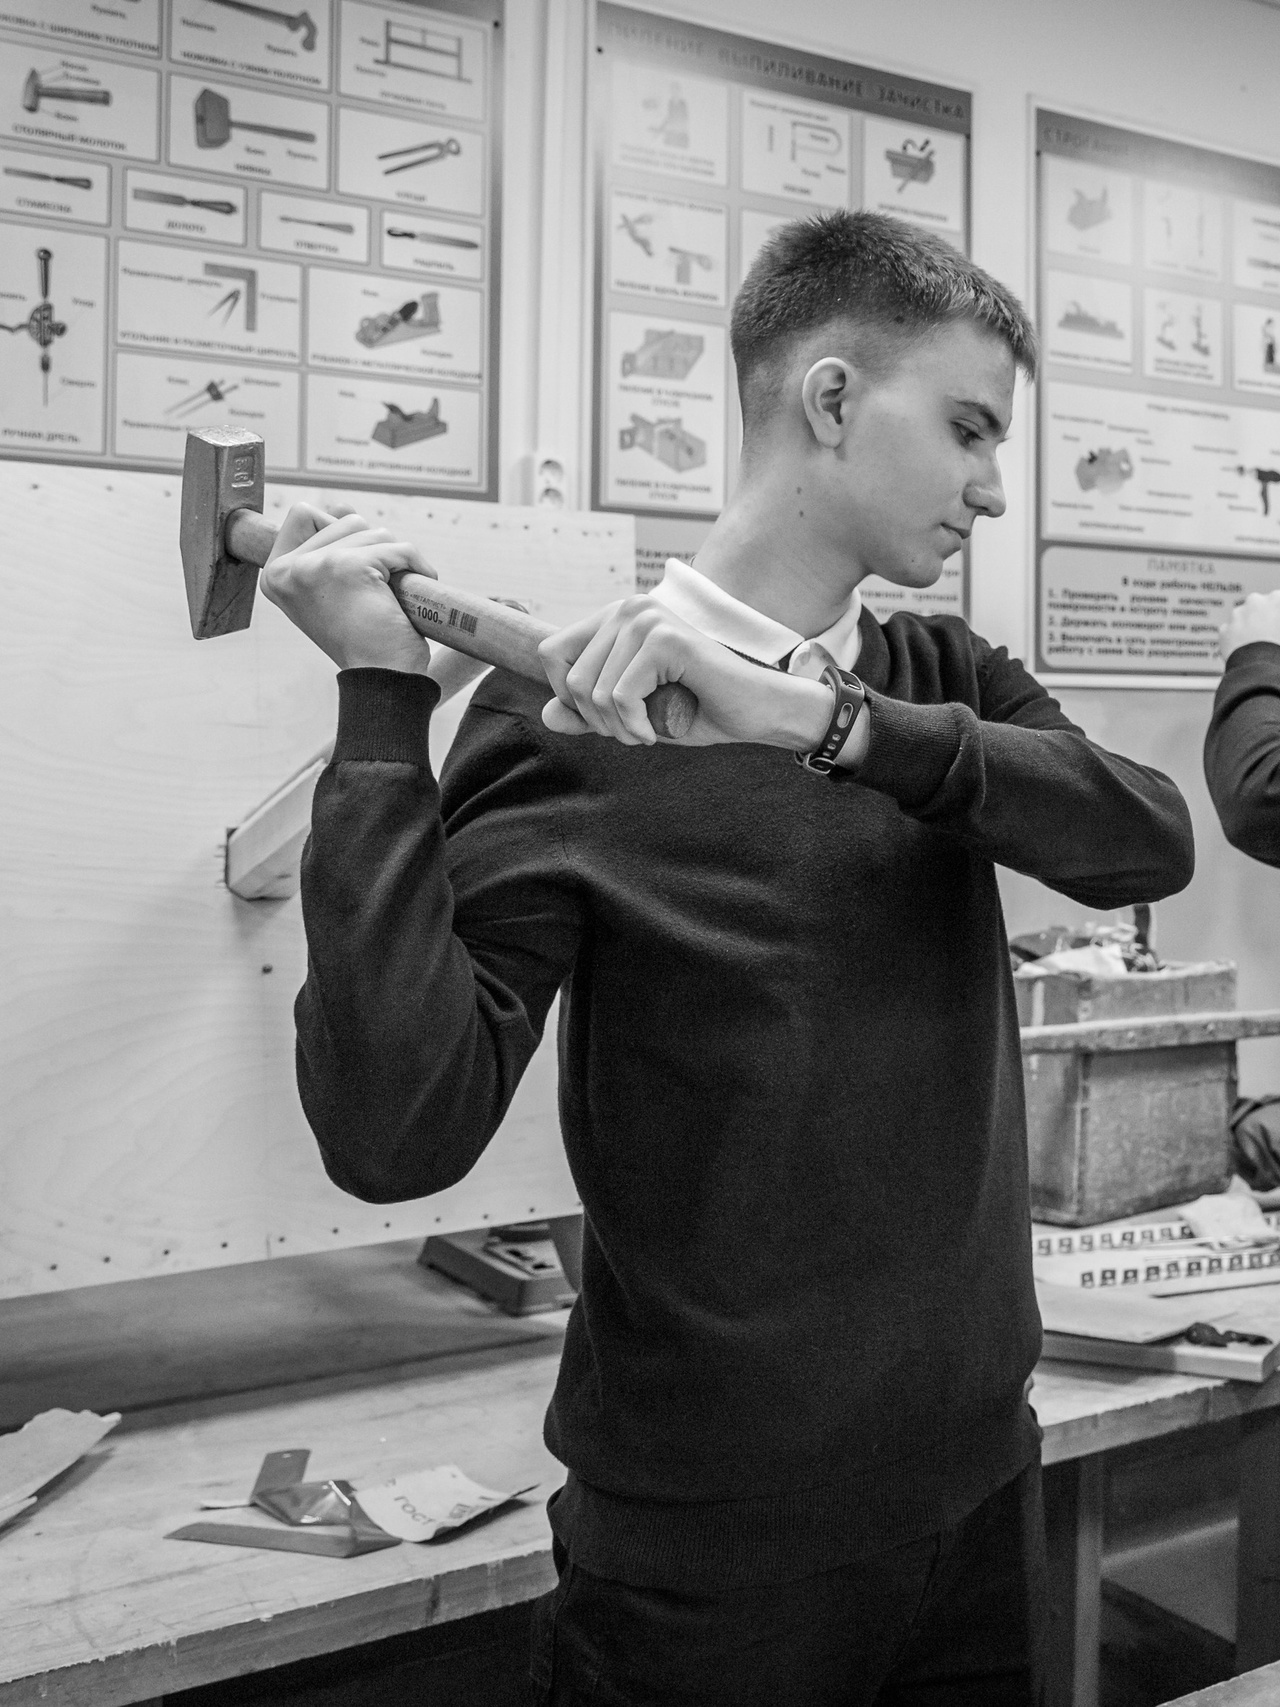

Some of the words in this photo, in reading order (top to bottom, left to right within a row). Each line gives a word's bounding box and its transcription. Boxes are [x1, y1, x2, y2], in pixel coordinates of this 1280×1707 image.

[1147, 558, 1216, 575] ПАМЯТКА
[417, 605, 439, 623] 1000
[394, 1496, 435, 1525] ГОСТ
